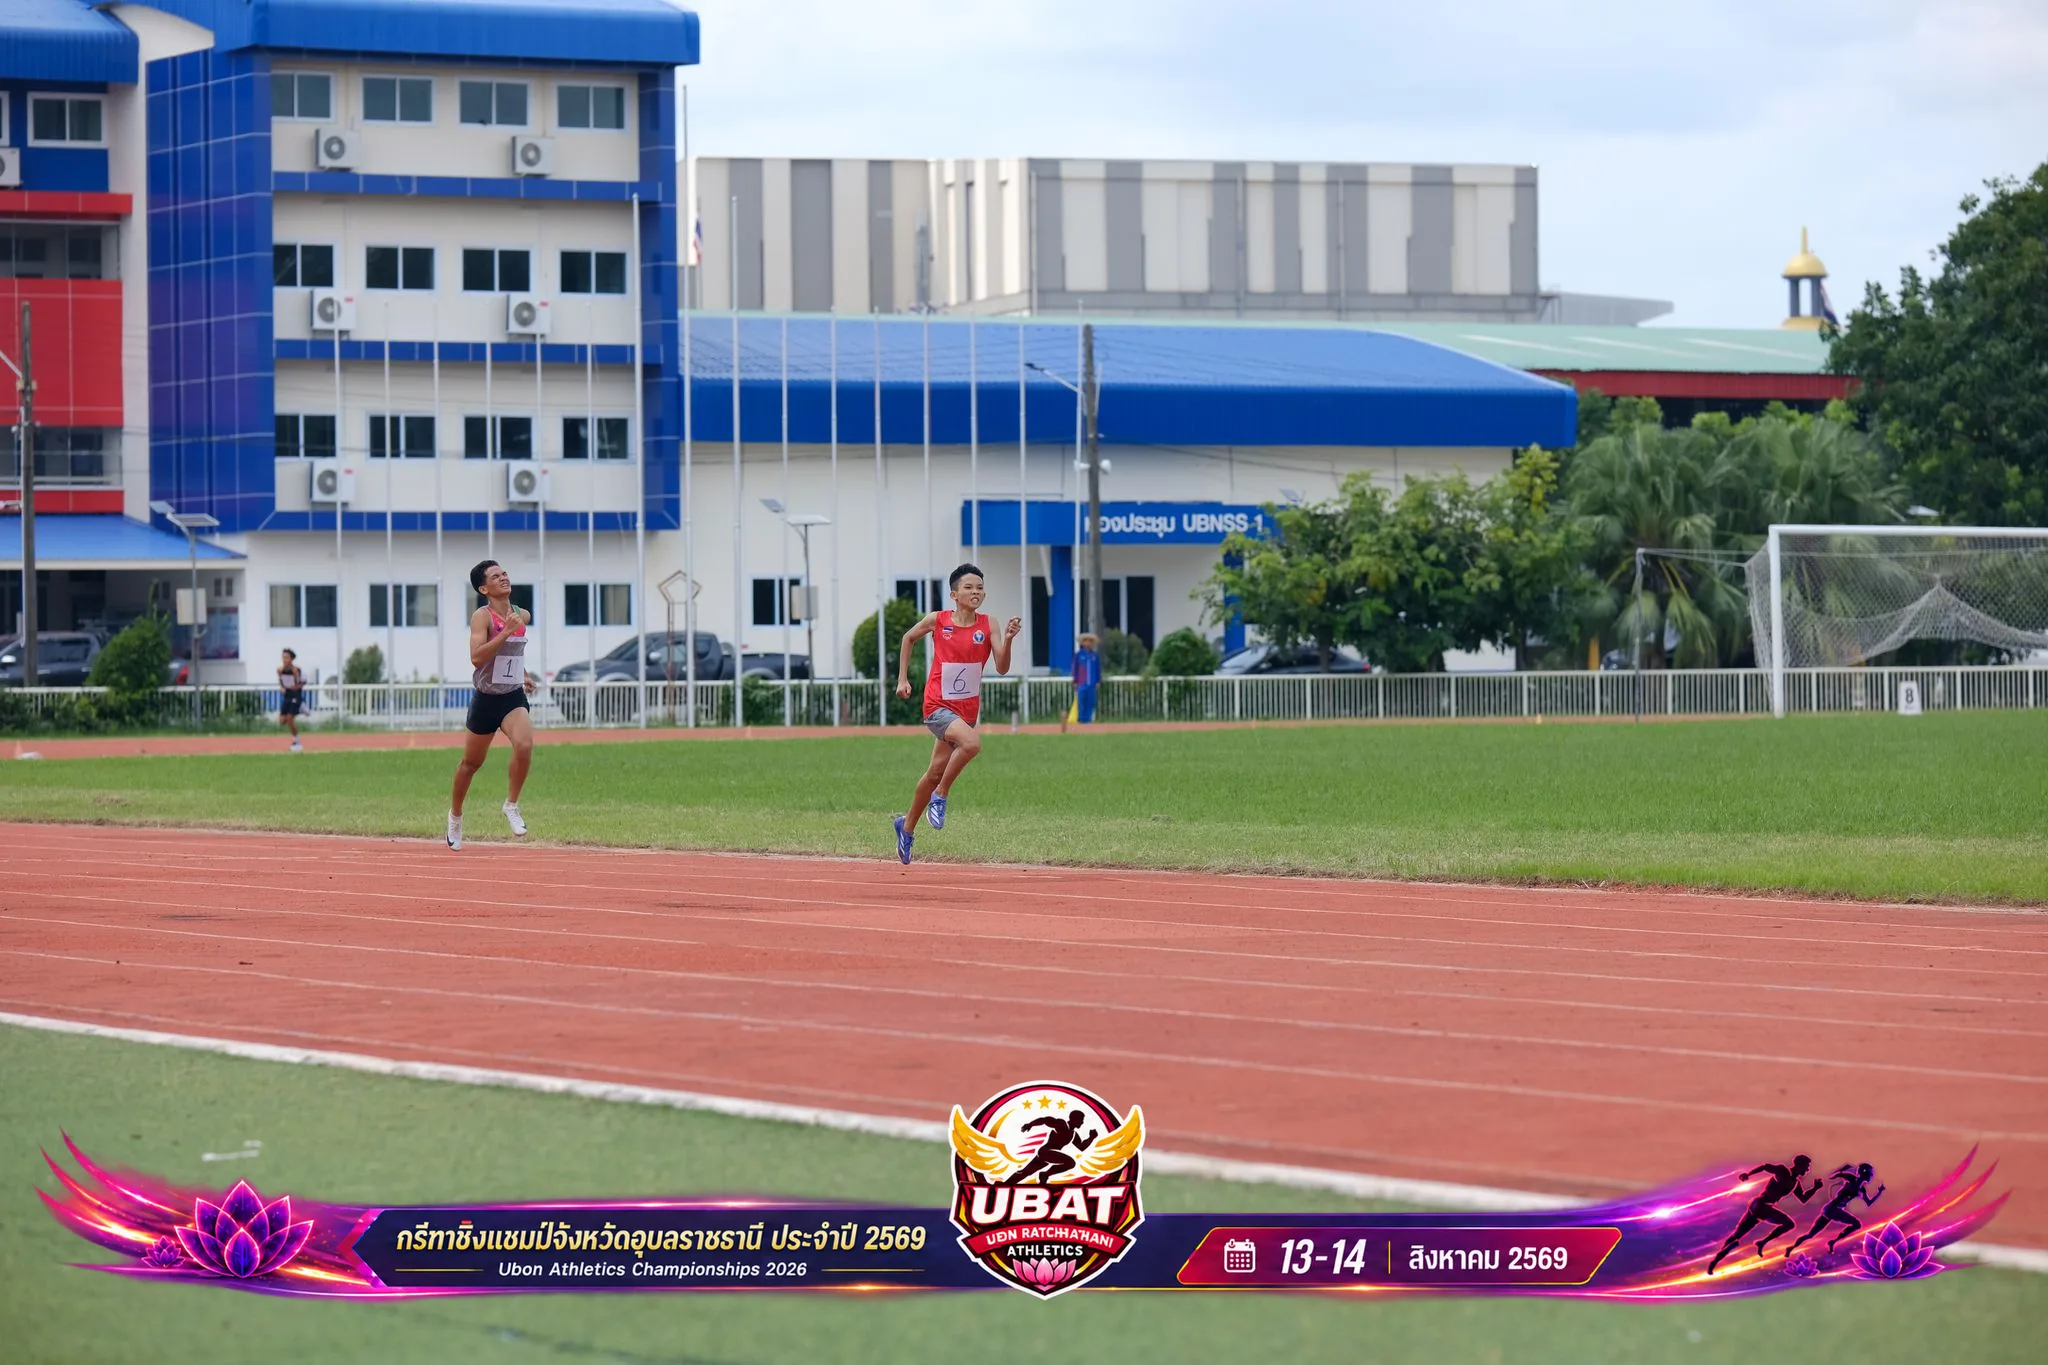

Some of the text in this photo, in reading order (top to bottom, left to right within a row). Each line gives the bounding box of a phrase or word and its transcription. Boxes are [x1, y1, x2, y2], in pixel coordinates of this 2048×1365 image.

[1182, 513, 1249, 533] UBNSS
[1254, 514, 1263, 533] 1
[502, 659, 514, 678] 1
[953, 667, 967, 692] 6
[1905, 687, 1914, 704] 8
